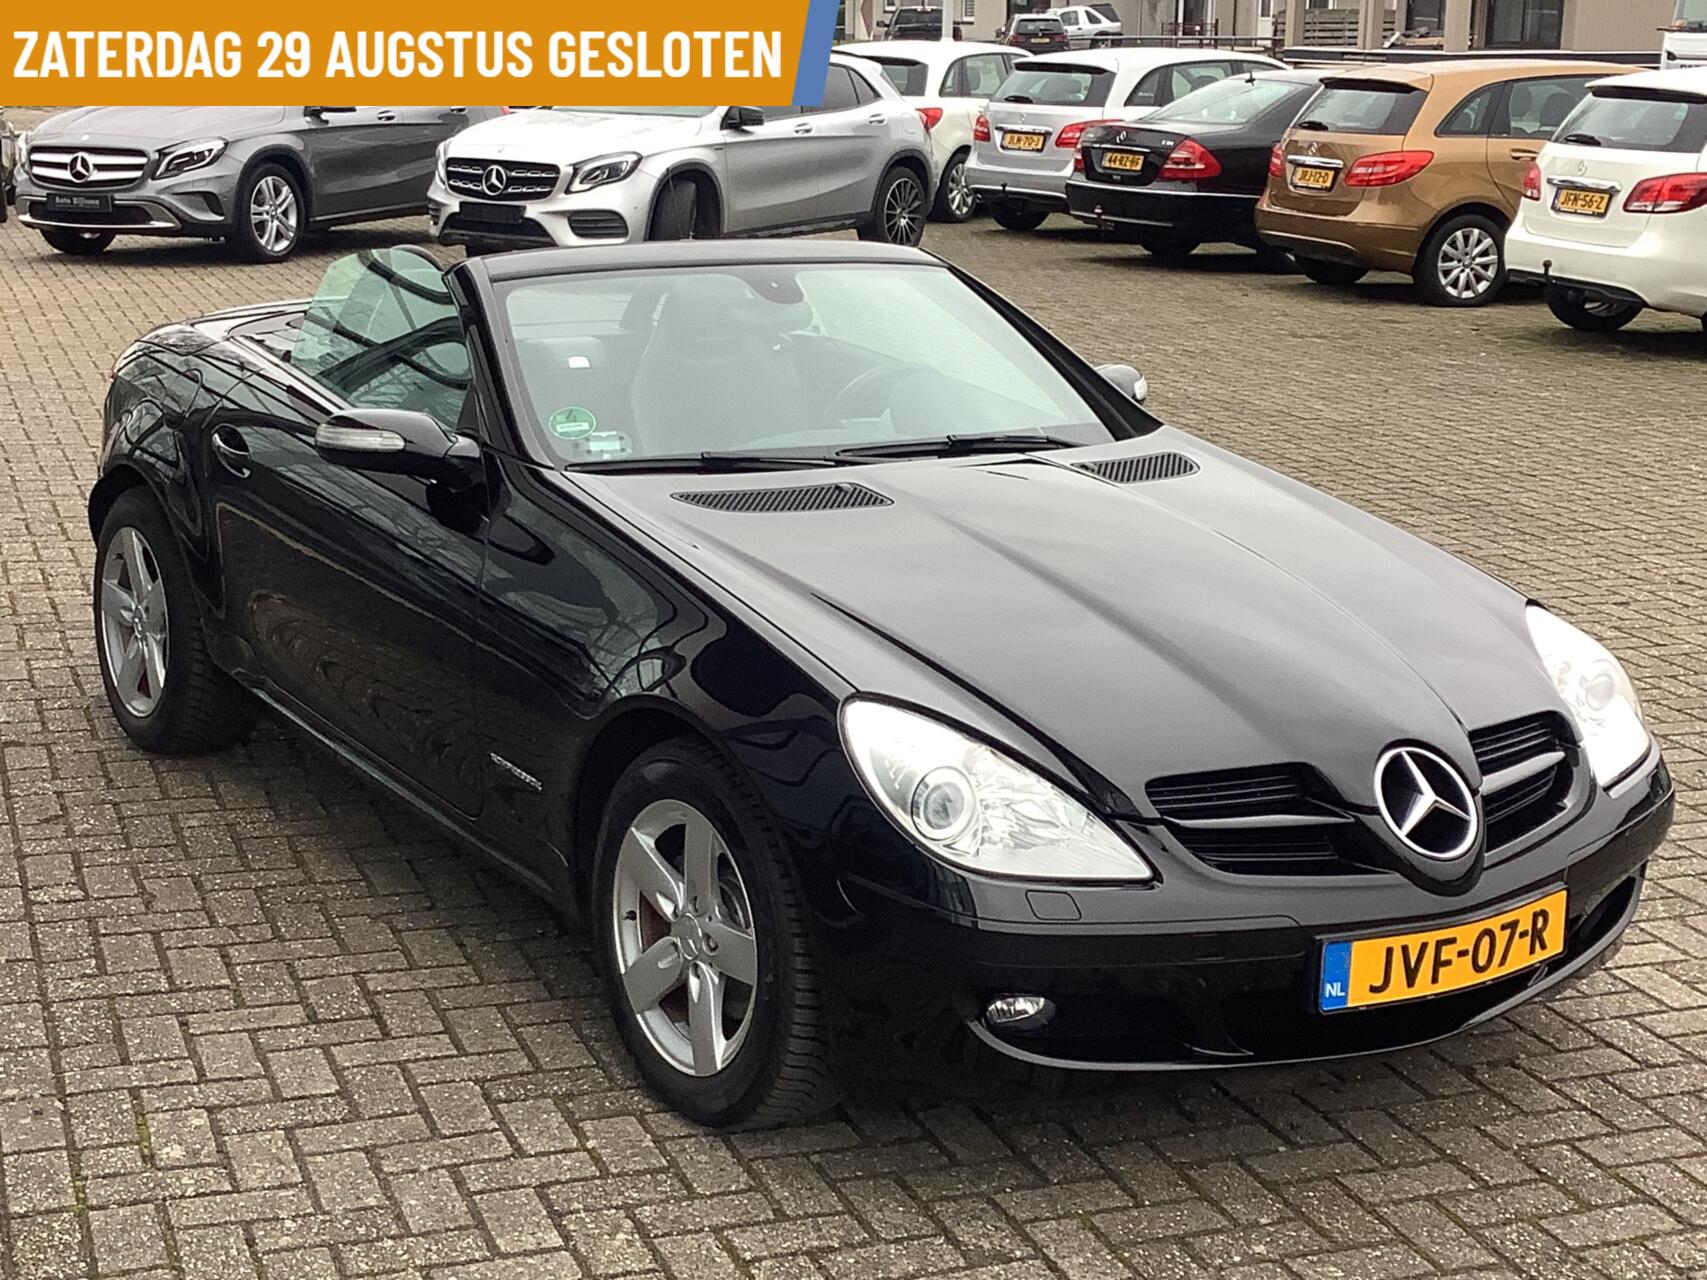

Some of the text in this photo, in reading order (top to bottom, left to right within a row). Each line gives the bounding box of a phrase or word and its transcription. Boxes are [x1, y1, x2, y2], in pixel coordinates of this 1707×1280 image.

[1560, 191, 1606, 210] JFN-56-Z
[1368, 908, 1550, 995] JVF-07-R
[1325, 981, 1346, 999] NL
